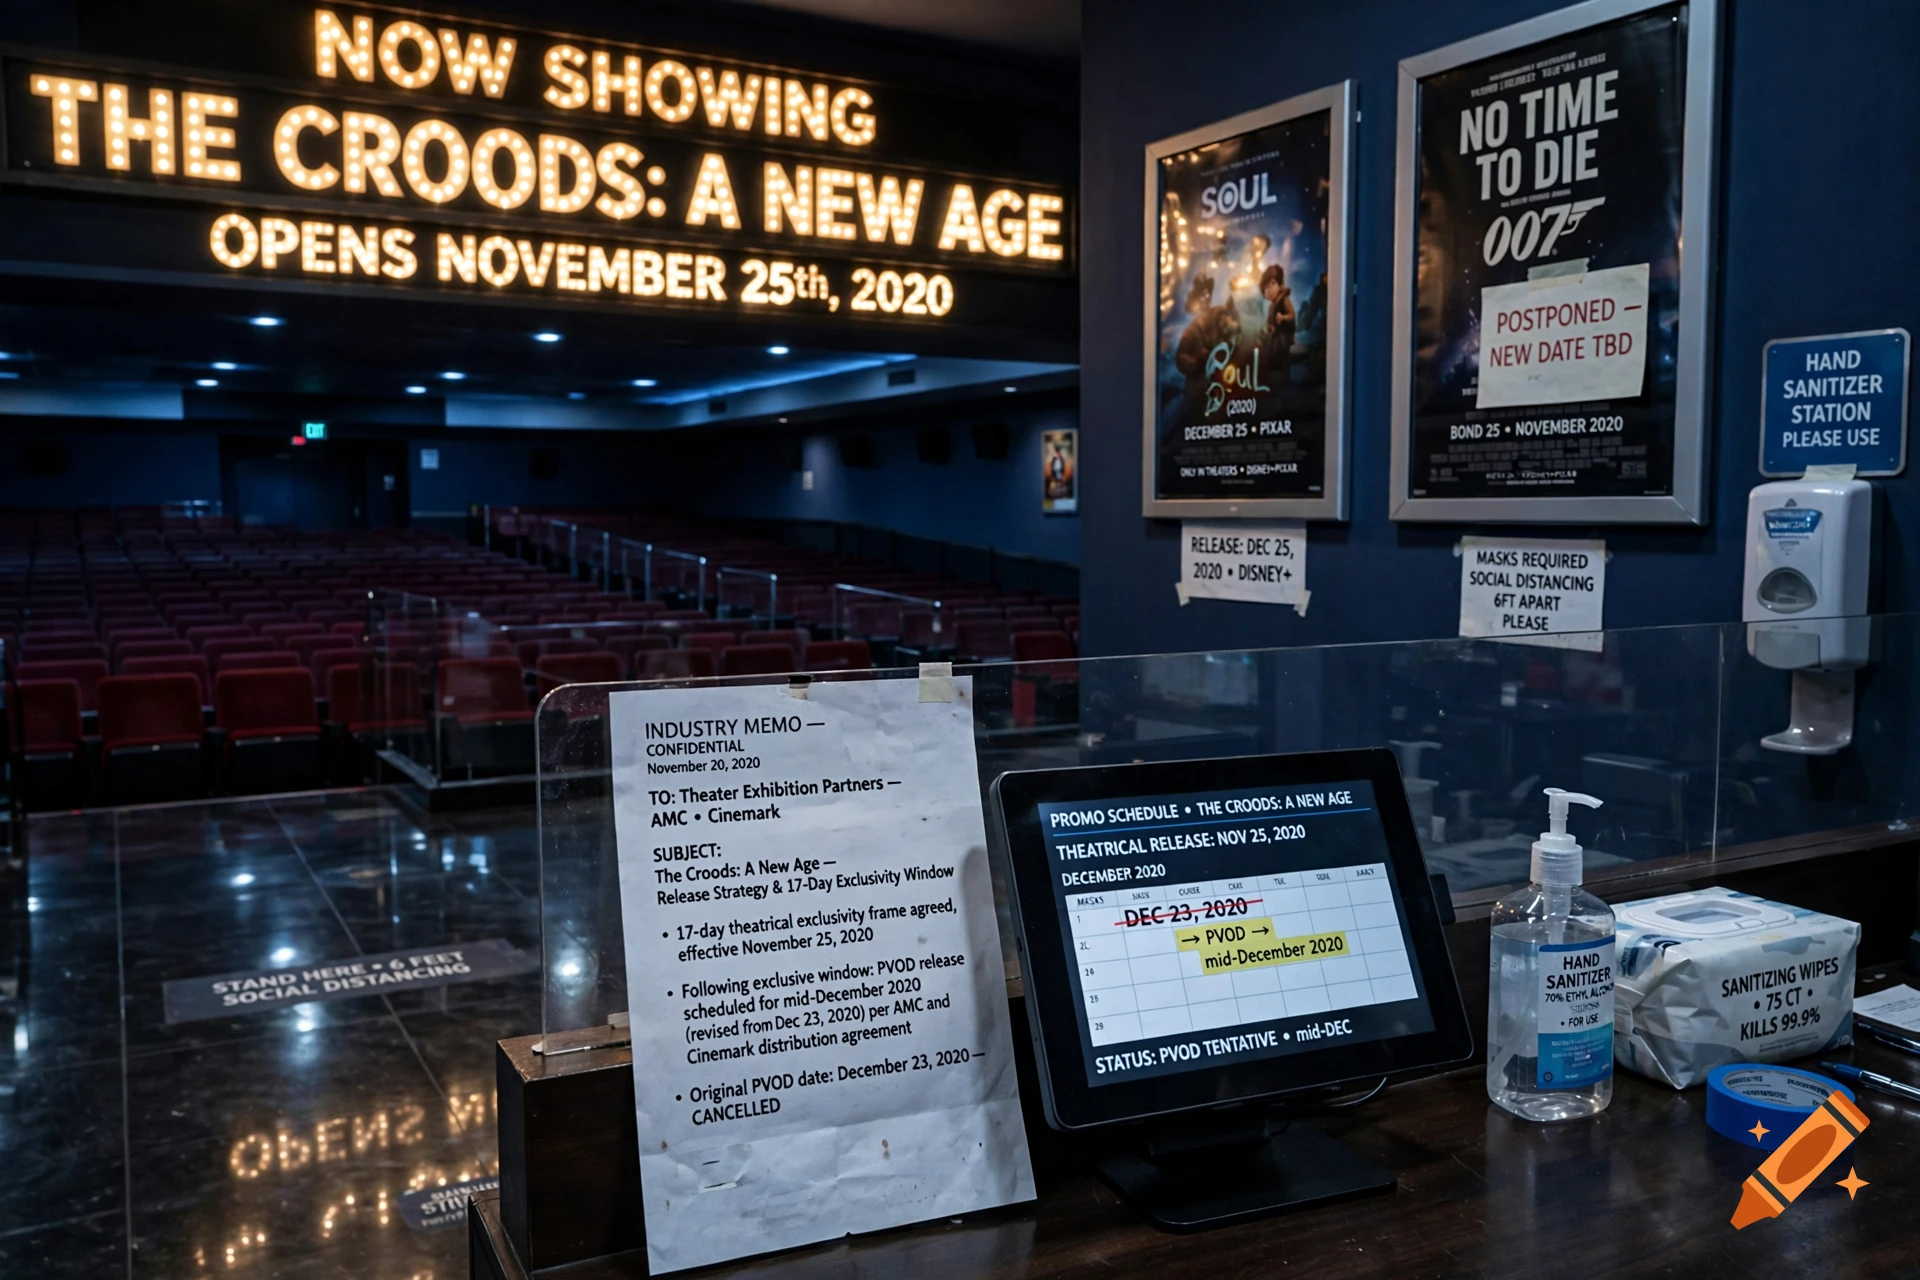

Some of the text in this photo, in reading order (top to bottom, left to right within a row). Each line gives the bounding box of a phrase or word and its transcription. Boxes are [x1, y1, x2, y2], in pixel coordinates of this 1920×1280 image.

[314, 9, 877, 147] NOW SHOWING
[1460, 100, 1509, 155] NO
[1519, 70, 1618, 139] TIME
[30, 73, 1064, 261] THE CROODS: A NEW AGE
[1475, 128, 1599, 201] TO DIE
[1201, 172, 1277, 218] SOUL
[1483, 202, 1580, 266] 007
[210, 213, 954, 317] OPENS NOVEMBER 25th, 2020
[1497, 297, 1616, 334] POSTPONED
[1490, 332, 1633, 367] NEW DATE TBD
[1806, 349, 1861, 372] HAND
[1783, 374, 1883, 399] SANITIZER
[1226, 398, 1257, 417] (2020)
[1791, 401, 1871, 424] STATION
[1184, 419, 1292, 441] DECEMBER 25 PIXAR
[1450, 415, 1624, 440] BOND 25 NOVEMBER 2020
[1782, 427, 1880, 448] PLEASE USE
[1191, 536, 1294, 560] RELEASE: DEC 25,
[1476, 550, 1589, 571] MASKS REQUIRED
[1193, 561, 1292, 583] 2020 DISNEY+
[1469, 570, 1594, 593] SOCIAL DISTANCING
[1493, 592, 1561, 611] 6FT APART
[1502, 613, 1549, 632] PLEASE
[645, 715, 802, 740] INDUSTRY MEMO
[646, 739, 745, 757] CONFIDENTIAL
[647, 756, 761, 775] November 20, 2020
[648, 778, 884, 806] TO: Theater Exhibition Partners
[650, 803, 781, 828] AMC Cinemark
[1049, 790, 1353, 828] PROMO SCHEDULE THE CROODS: A NEW AGE
[653, 842, 722, 863] SUBJECT:
[1055, 824, 1306, 861] THEATRICAL RELEASE: NOV 25, 2020
[654, 857, 820, 884] The Croods: A New Age
[657, 864, 955, 906] Release Strategy & 17-Day Exclusivity Window
[1061, 863, 1166, 887] DECEMBER 2020
[676, 897, 957, 941] 17-day theatrical exclusivity frame agreed,
[1125, 897, 1248, 928] DEC 23, 2020
[678, 926, 874, 962] effective November 25, 2020
[1205, 925, 1246, 945] PVOD
[1204, 935, 1344, 969] mid-December 2020
[1563, 952, 1600, 971] HAND
[212, 951, 463, 995] STAND HERE 6 FEET
[222, 962, 471, 1007] SOCIAL DISTANCING
[681, 953, 965, 999] Following exclusive window: PVOD release
[1546, 966, 1611, 990] SANITIZER
[1721, 956, 1839, 998] SANITIZING WIPES
[683, 977, 922, 1021] scheduled for mid-December 2020
[1545, 993, 1564, 1003] 70%
[1766, 986, 1802, 1012] 75 CT
[685, 992, 951, 1045] (revised from Dec 23, 2020) per AMC and
[1569, 1013, 1598, 1027] FOR USE
[1740, 1006, 1821, 1042] KILLS 99.9%
[686, 1020, 913, 1065] Cinemark distribution agreement
[1095, 1018, 1353, 1074] STATUS: PVOD TENTATIVE mid-DEC
[689, 1047, 970, 1105] Original PVOD date: December 23, 2020
[691, 1097, 781, 1127] CANCELLED
